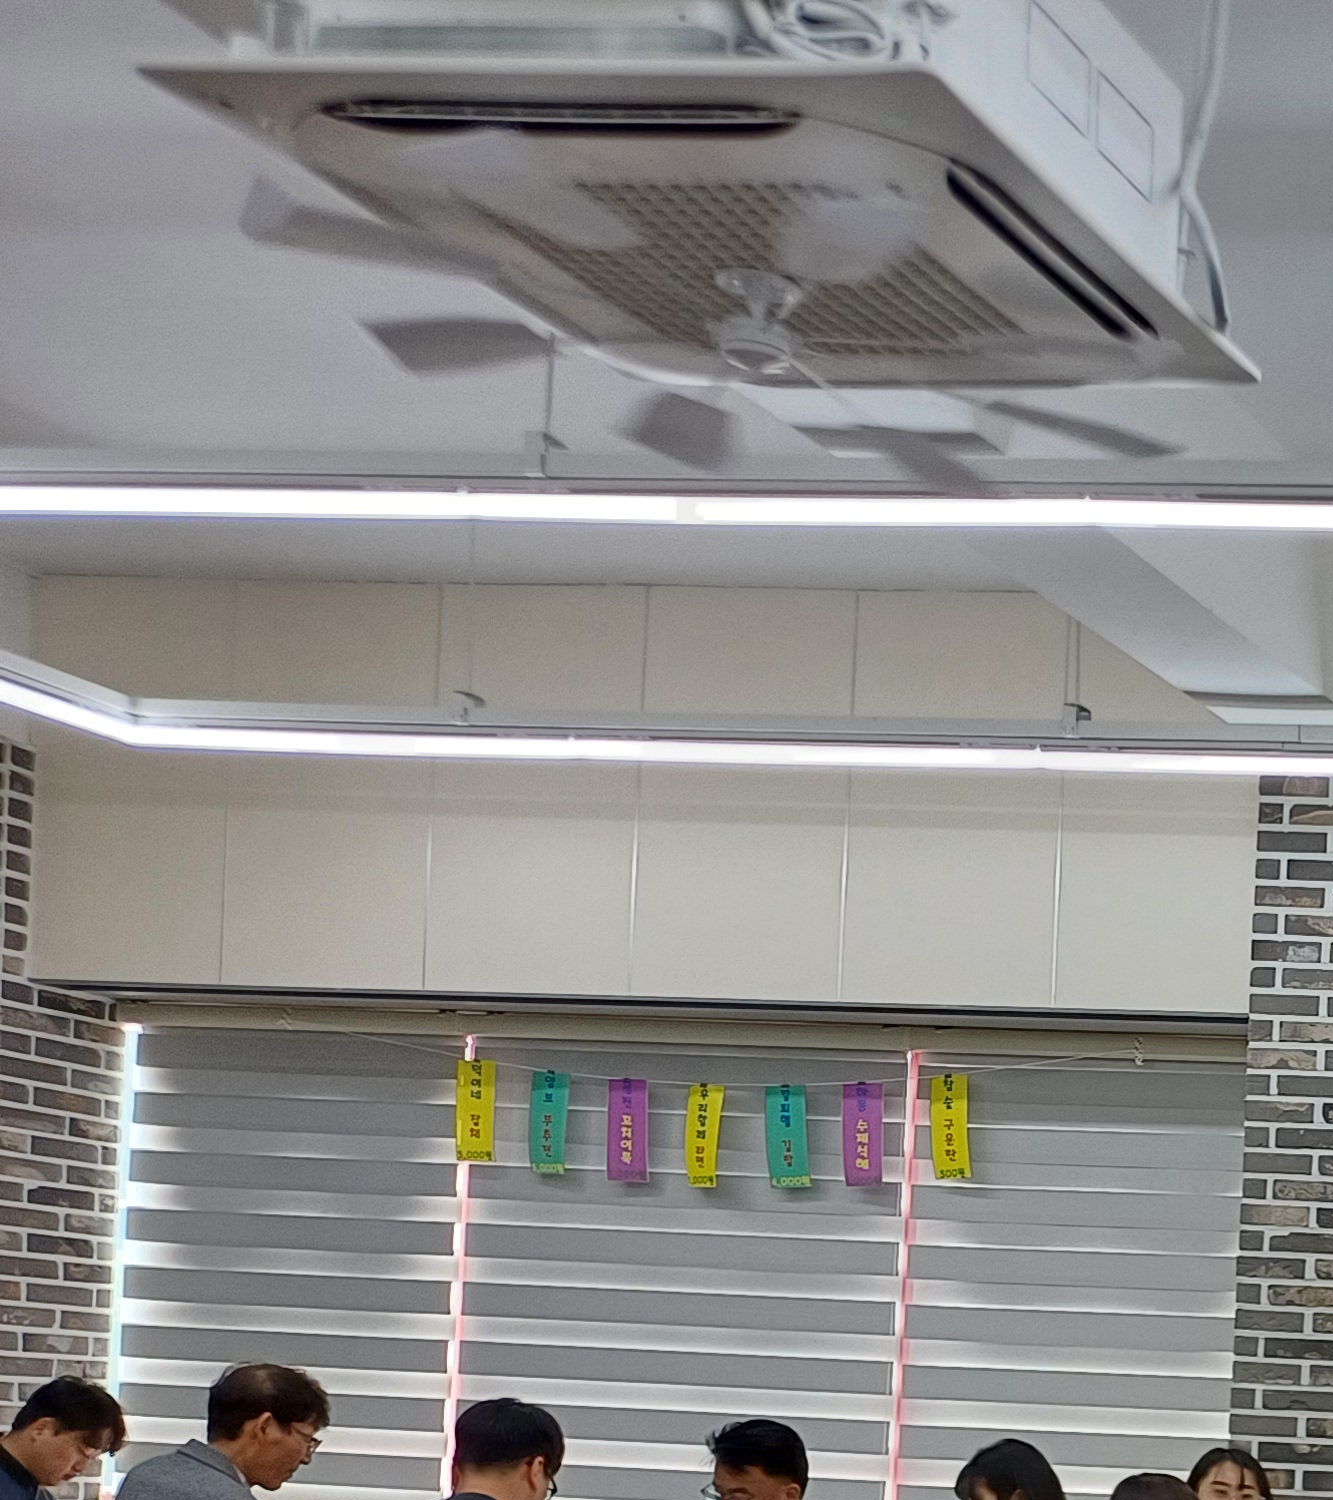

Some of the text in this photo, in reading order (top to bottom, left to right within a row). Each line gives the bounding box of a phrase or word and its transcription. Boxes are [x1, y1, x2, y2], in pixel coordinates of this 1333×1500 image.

[541, 1114, 553, 1158] 부추전
[781, 1139, 793, 1168] 김밥
[943, 1119, 956, 1162] 구운란
[694, 1146, 705, 1168] 라면
